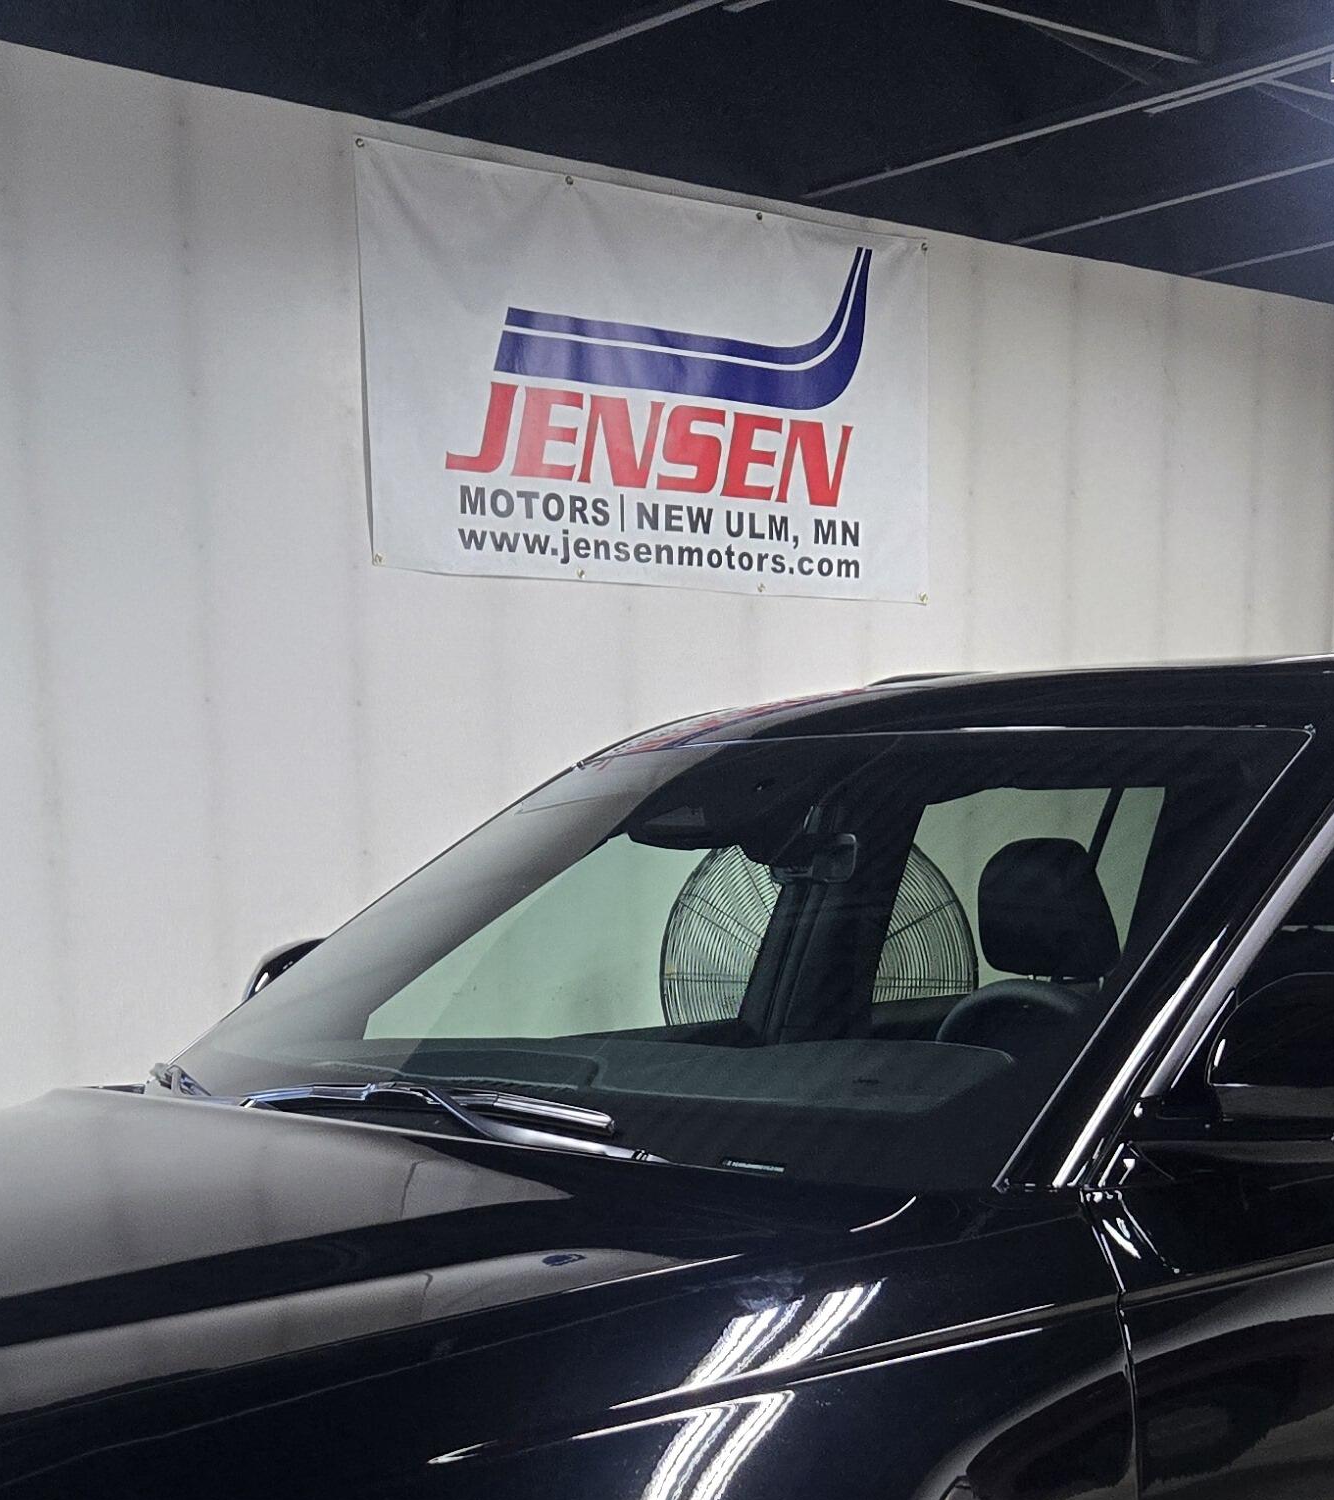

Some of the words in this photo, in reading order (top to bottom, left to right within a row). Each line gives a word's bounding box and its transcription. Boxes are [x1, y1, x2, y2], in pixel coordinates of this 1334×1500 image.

[445, 382, 853, 507] JENSEN
[459, 485, 610, 527] MOTORS
[637, 502, 713, 535] NEW
[726, 510, 799, 550] ULM,
[813, 518, 860, 547] MN
[458, 528, 861, 579] www.jensenmotors.com
